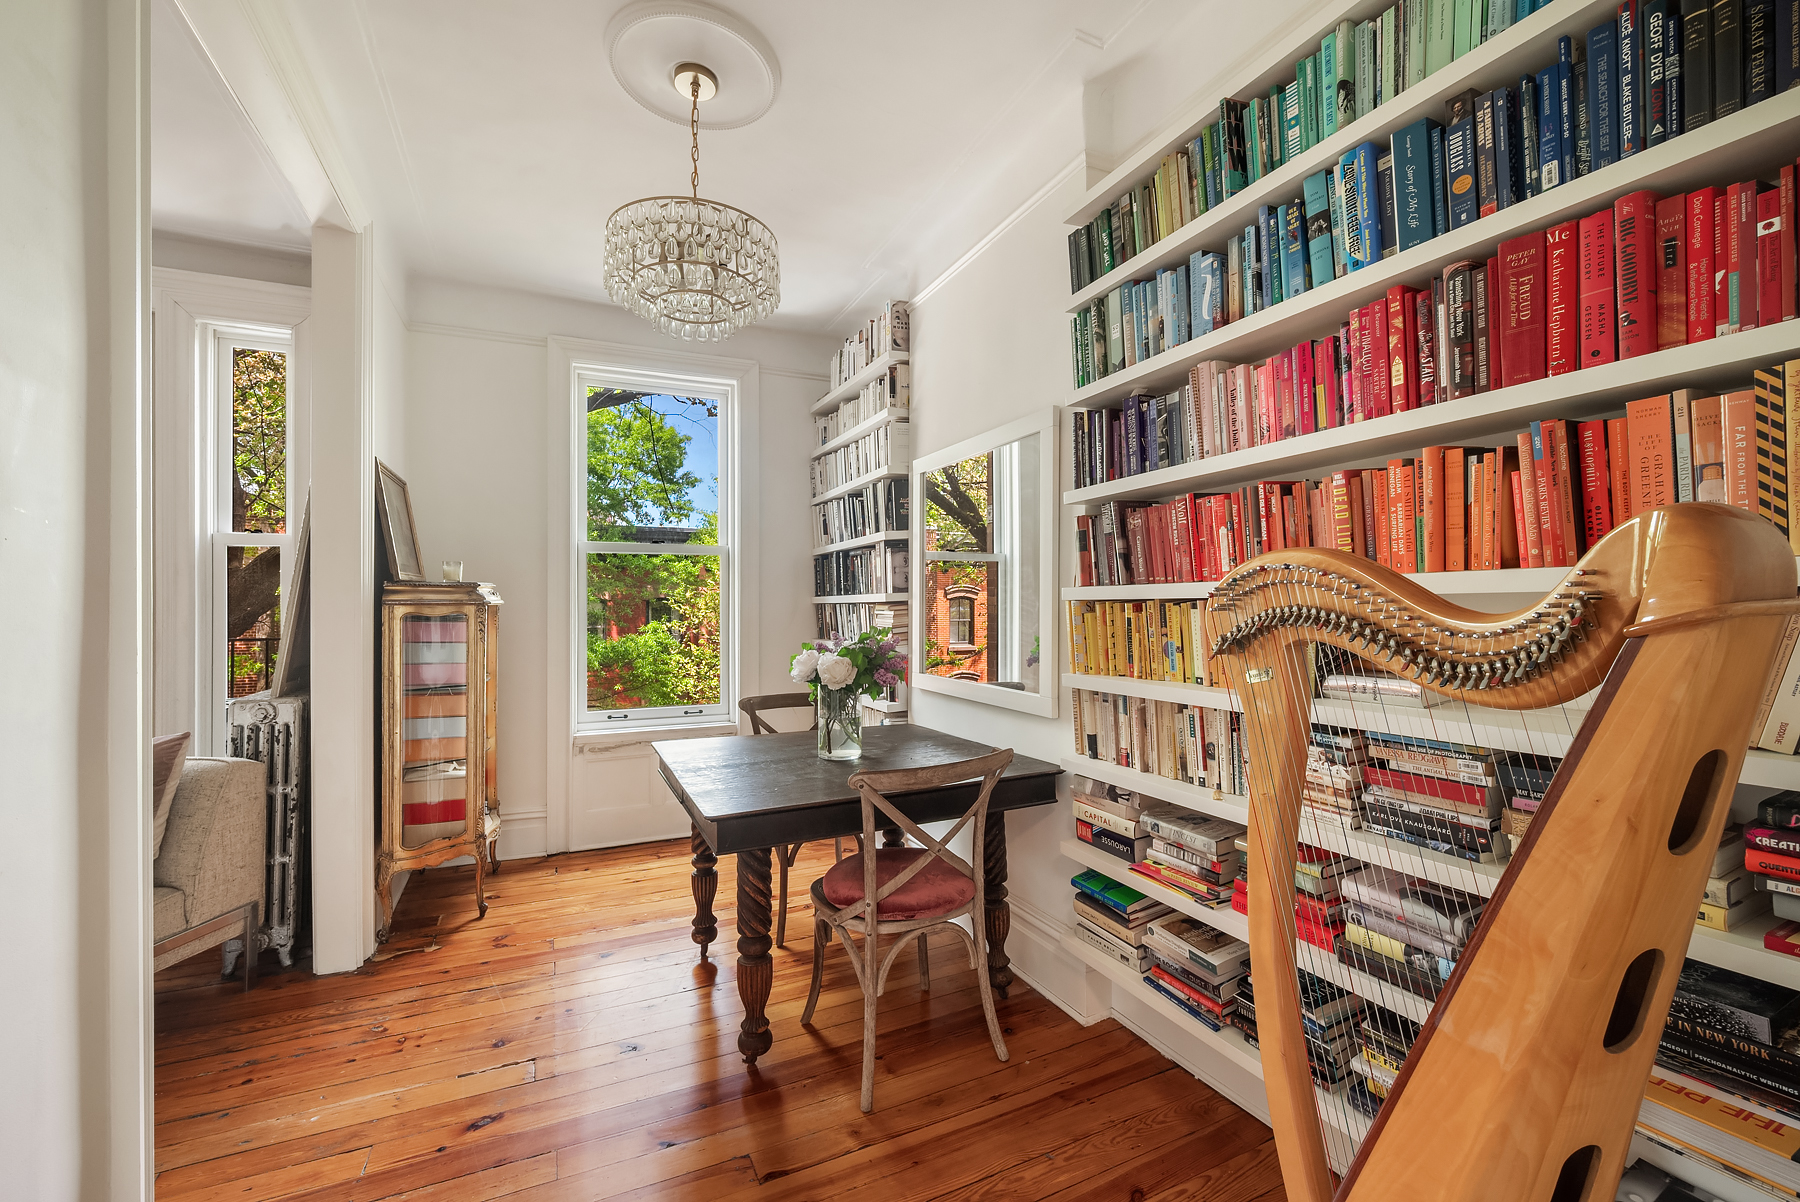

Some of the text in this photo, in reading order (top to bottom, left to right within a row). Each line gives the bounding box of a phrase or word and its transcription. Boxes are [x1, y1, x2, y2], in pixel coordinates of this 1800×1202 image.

[1621, 11, 1631, 71] ALICE KNOTT
[1751, 5, 1765, 94] SARAH PERRY
[1597, 54, 1607, 71] THE
[1650, 12, 1664, 121] GEOFF DYER ZONA
[1598, 73, 1607, 101] SEARCH
[1599, 102, 1608, 117] FOR
[1622, 75, 1631, 138] BLAKE BUTLER
[1476, 109, 1485, 146] TO ARMS
[1484, 108, 1492, 149] FAREWELL
[1599, 118, 1609, 133] THE
[1449, 131, 1464, 173] DOUGLASS
[1600, 135, 1609, 151] SELF
[1405, 164, 1415, 185] Story
[1343, 161, 1360, 256] ZADIE SMITH FEEL FREE
[1407, 194, 1418, 212] My
[1764, 198, 1773, 214] Jones
[1409, 213, 1419, 228] Life
[1660, 224, 1680, 234] Nin
[1692, 196, 1703, 248] Dale Carnegie
[1546, 230, 1569, 245] Me
[1584, 230, 1590, 239] IS
[1506, 248, 1536, 261] PETER
[1511, 258, 1530, 267] GAY
[1597, 243, 1605, 278] FUTURE
[1620, 203, 1638, 306] The BIG GOODBYE
[1700, 258, 1708, 273] How
[1454, 275, 1463, 306] Vanishing
[1509, 281, 1517, 292] Life
[1690, 269, 1698, 298] Influence
[1700, 283, 1708, 295] Win
[1509, 292, 1517, 300] for
[1519, 274, 1534, 320] FREUD
[1550, 248, 1565, 358] Katharine Hepburn
[1701, 296, 1710, 320] Friends
[1690, 299, 1698, 321] People
[1456, 322, 1464, 337] York
[1381, 388, 1386, 400] TO
[1548, 430, 1556, 458] Incredible
[1559, 443, 1567, 470] Nocturne
[1582, 430, 1599, 492] MUSICOPHILIA
[1679, 456, 1688, 481] PARIS
[1735, 426, 1746, 495] FAR FROM THE
[1403, 474, 1411, 489] ALI
[1521, 443, 1538, 540] Wintering Katherine May
[1538, 477, 1547, 499] PARIS
[1641, 456, 1650, 508] GREENE
[1654, 454, 1665, 507] GRAHAM
[1404, 491, 1412, 520] SMITH
[1681, 483, 1690, 504] REVI
[1177, 501, 1186, 524] Wolf
[1334, 488, 1351, 552] DEAD LION
[1540, 501, 1550, 530] REVIEW
[1586, 509, 1594, 538] SACKS
[1594, 506, 1603, 540] OLIVER
[1375, 747, 1448, 766] VANESSA REDGRAVE
[1435, 750, 1473, 760] PHOTOGRAPHY
[1084, 810, 1112, 827] CAPITAL
[1101, 836, 1131, 854] LAROUSSE
[1172, 829, 1198, 844] INCEST
[1755, 836, 1800, 852] CREATI
[1758, 861, 1800, 876] QUENTI
[1659, 1041, 1688, 1055] RGEOIS
[1678, 1021, 1770, 1060] IN NEW YORK
[1694, 1053, 1799, 1096] PSYCHOANALYTIC WRITINGS
[1719, 1105, 1787, 1137] THE
